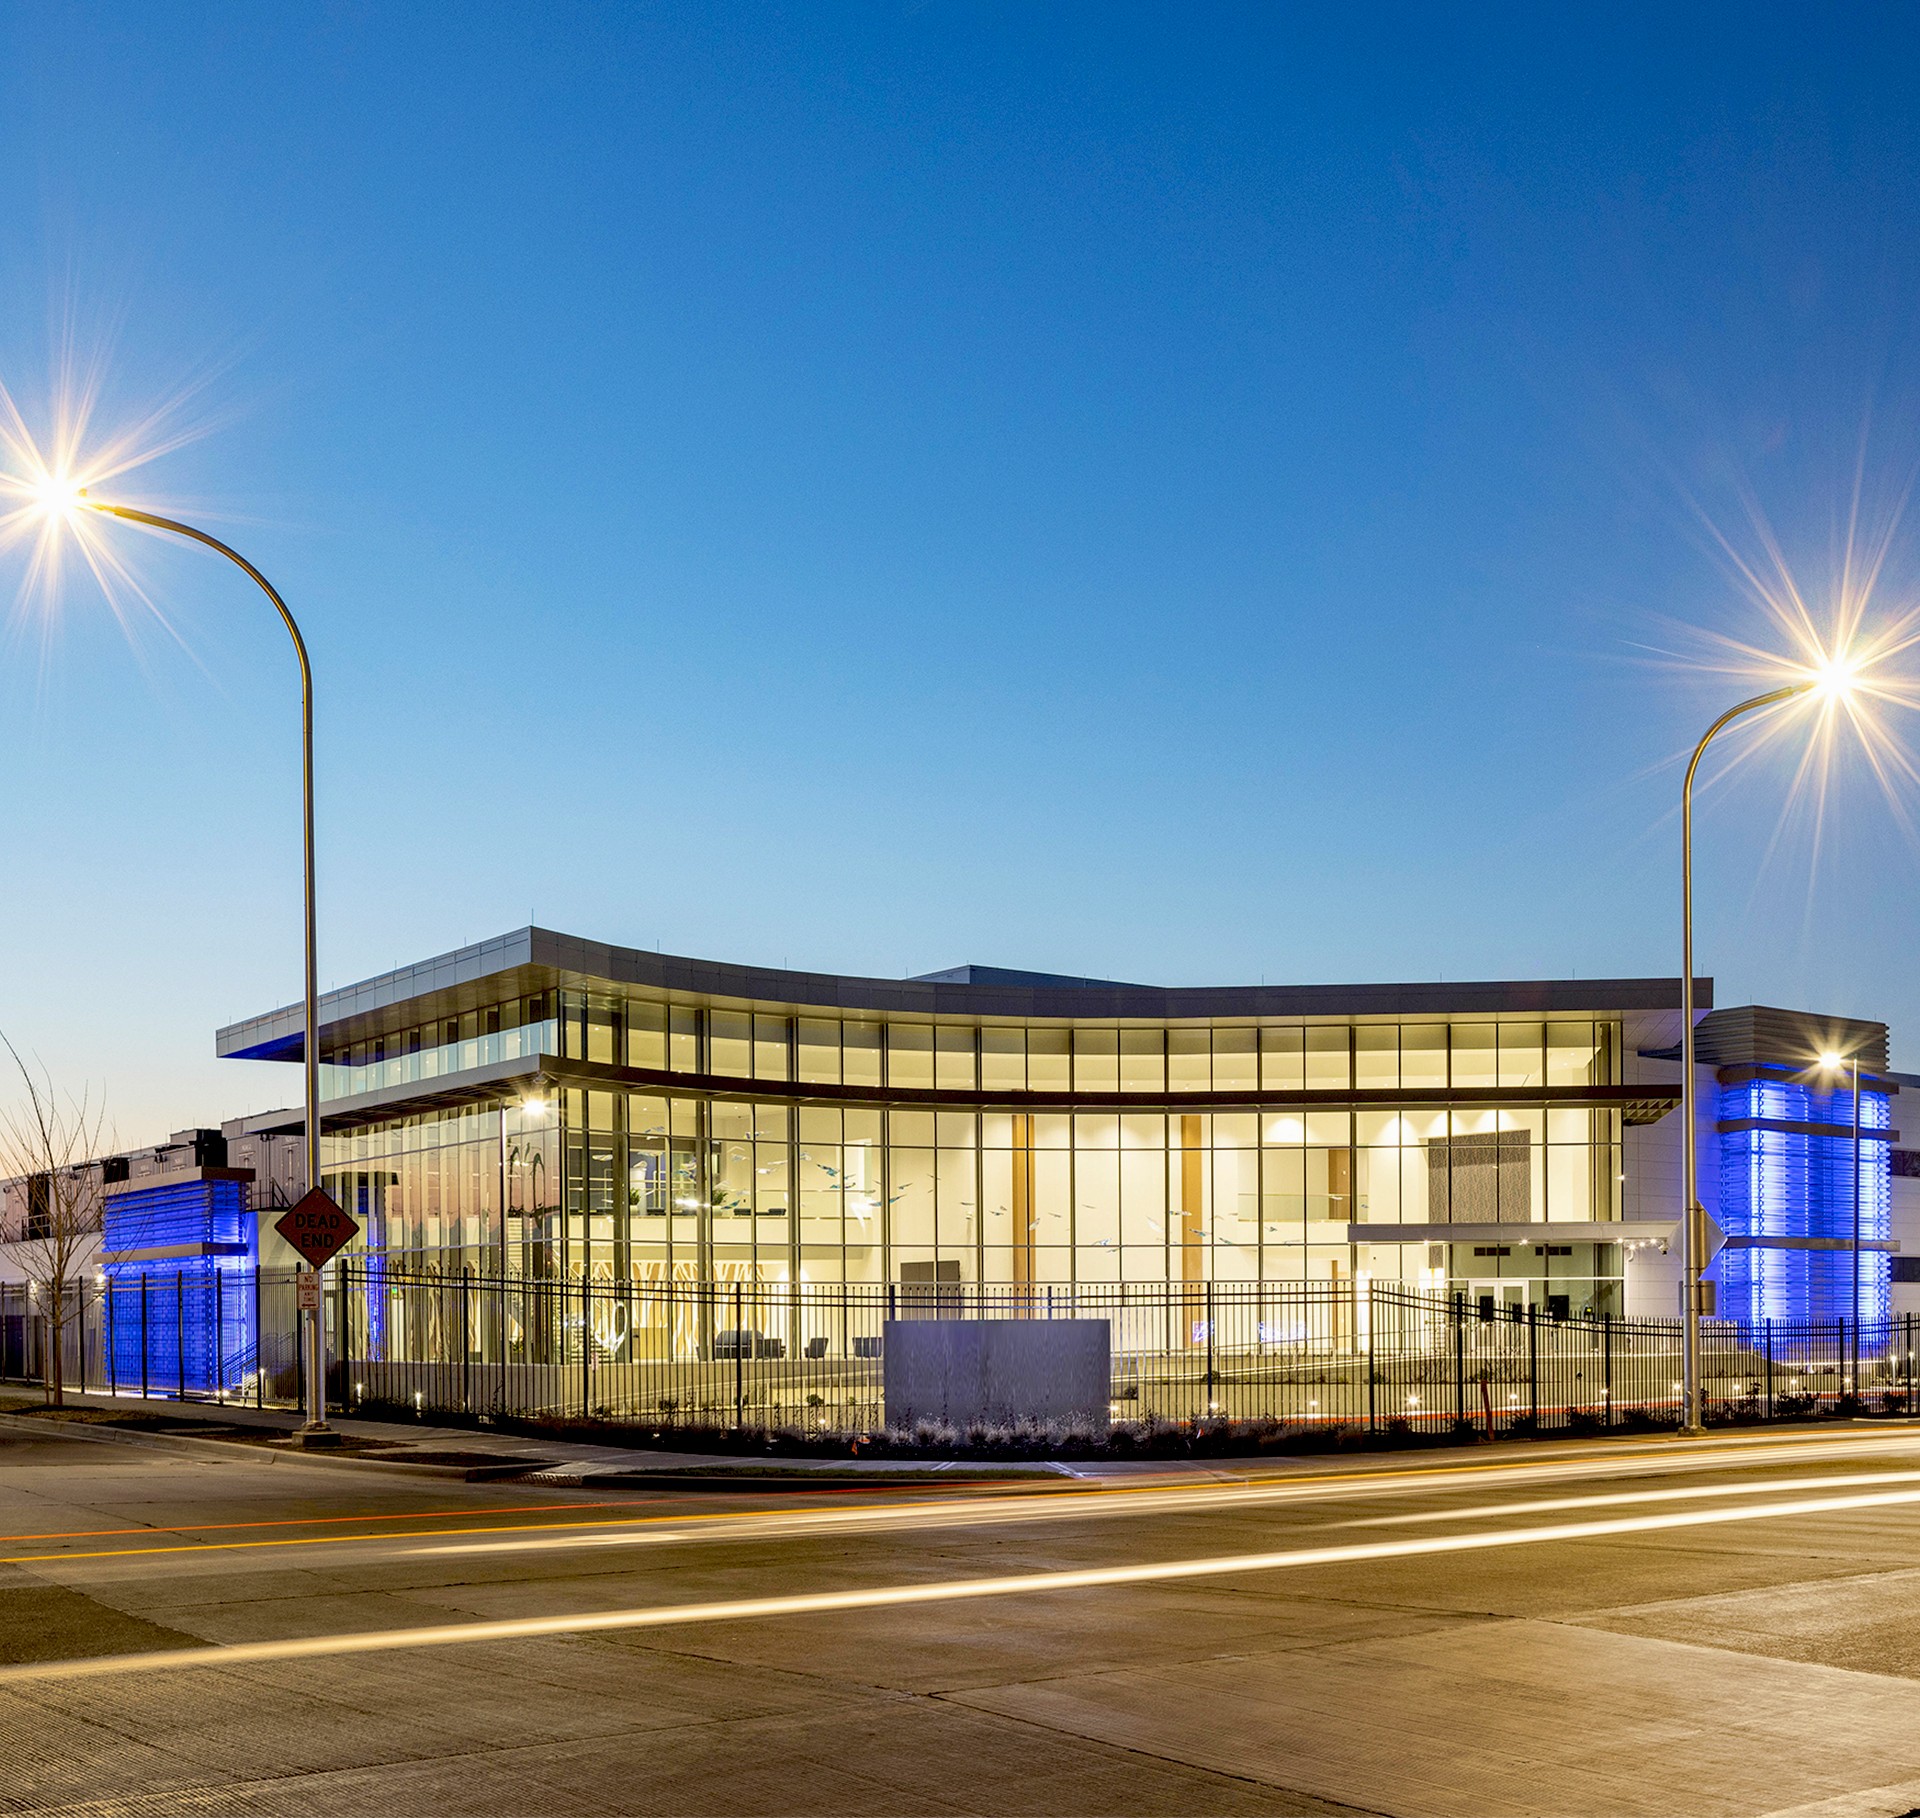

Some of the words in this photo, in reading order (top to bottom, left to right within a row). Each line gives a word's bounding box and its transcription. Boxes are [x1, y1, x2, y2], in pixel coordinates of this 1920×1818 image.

[295, 1213, 340, 1229] DEAD
[301, 1232, 335, 1249] END
[304, 1275, 314, 1283] NO
